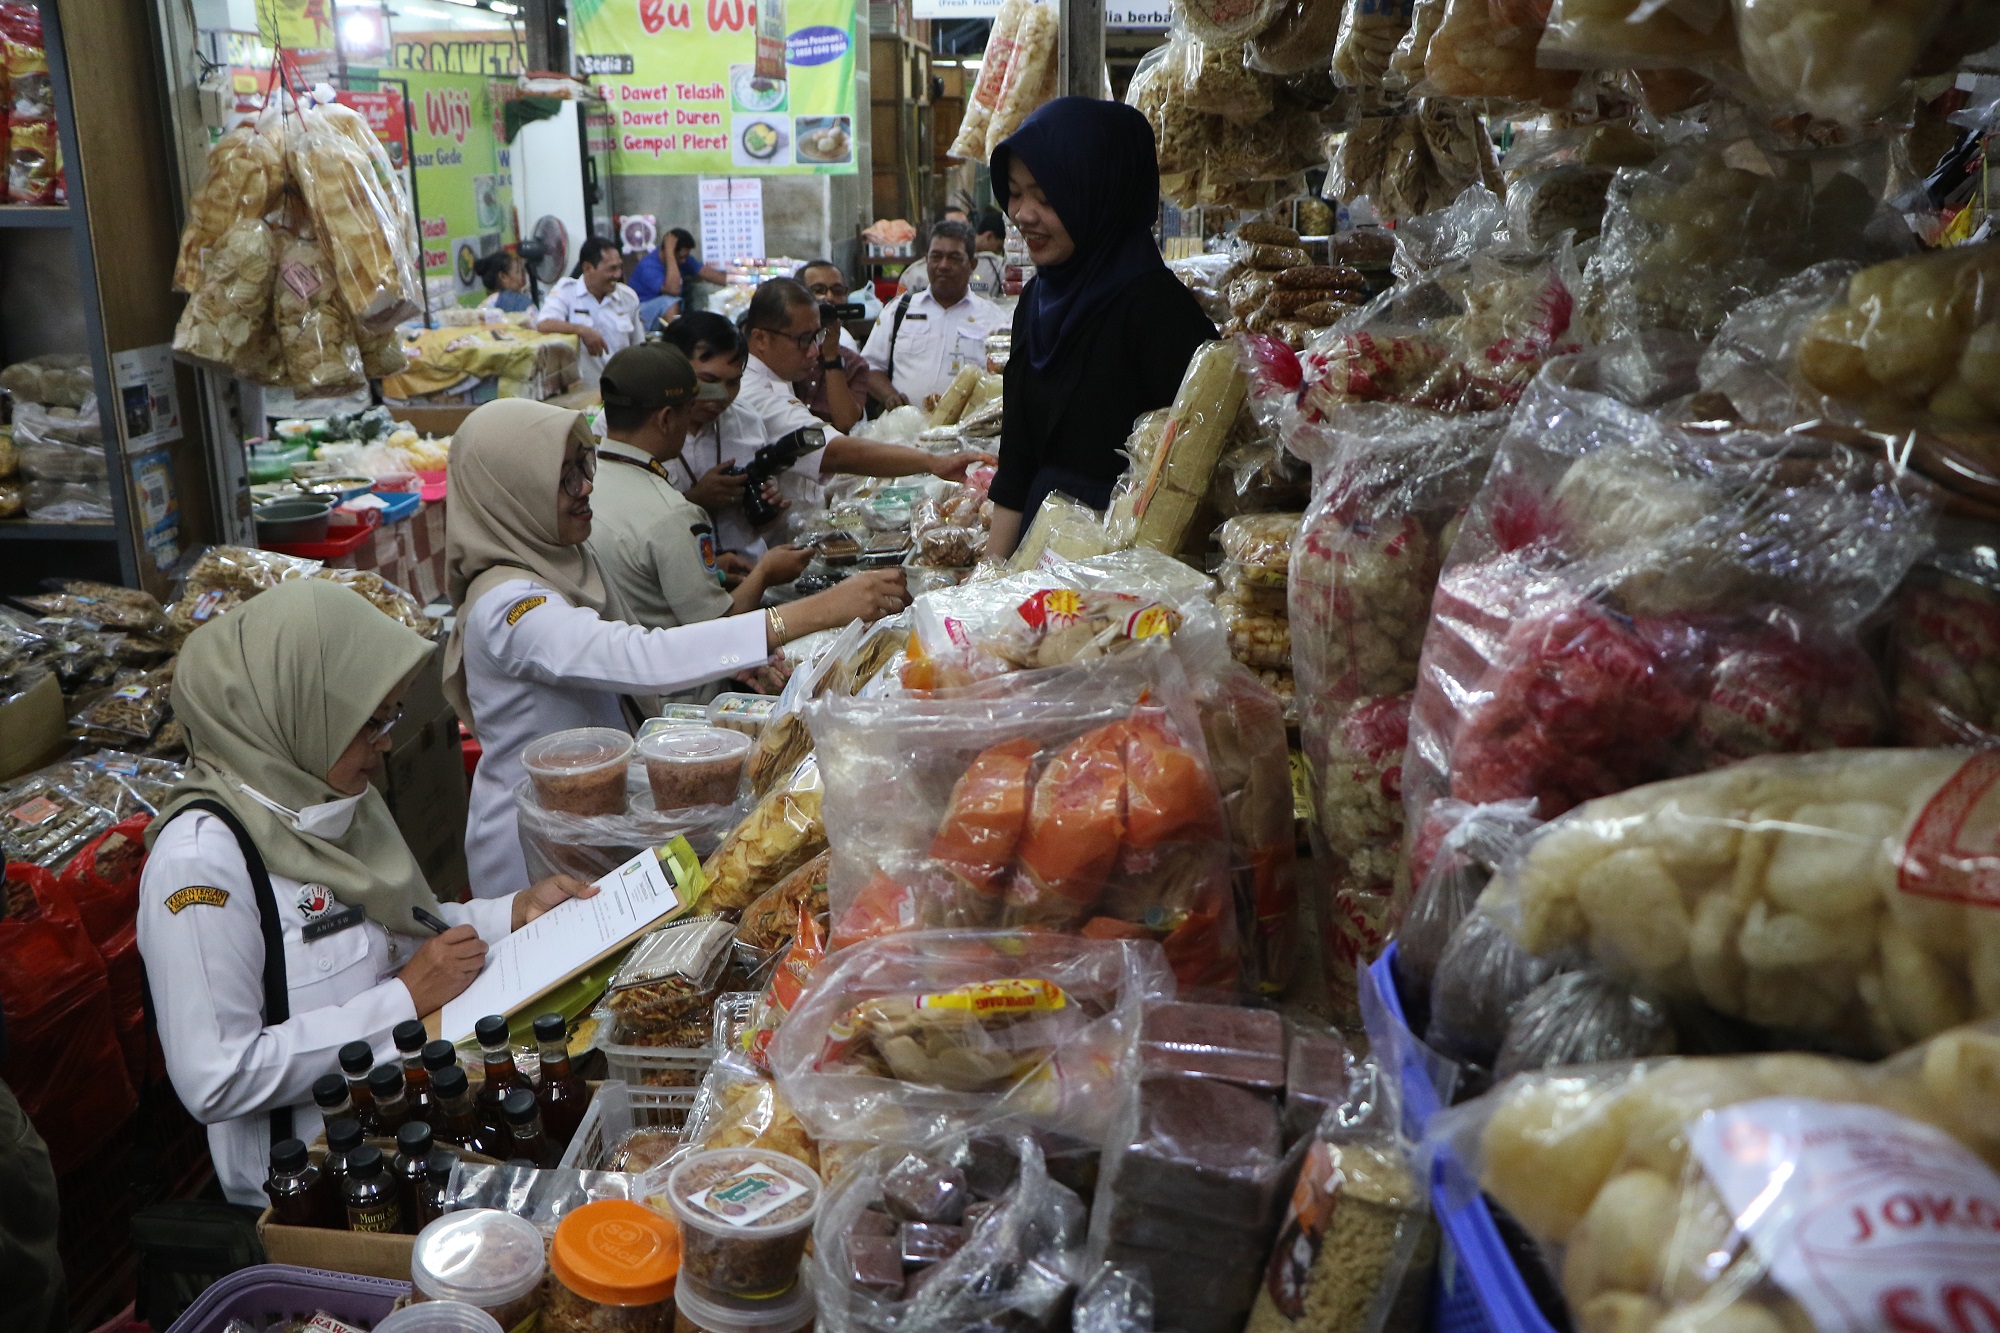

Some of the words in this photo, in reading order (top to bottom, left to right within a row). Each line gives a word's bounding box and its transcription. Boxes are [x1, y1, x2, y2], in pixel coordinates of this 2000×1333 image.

[639, 0, 690, 34] Bu
[430, 42, 512, 75] DAWET
[584, 56, 622, 74] Sedia
[622, 84, 668, 100] Dawet
[676, 83, 725, 99] Telasih
[425, 91, 471, 143] Wiji
[623, 109, 669, 125] Dawet
[676, 109, 720, 125] Duren
[624, 134, 676, 158] Gempol
[683, 134, 728, 150] Pleret
[436, 147, 462, 165] Gede
[169, 887, 225, 906] KEMENTERIAN
[316, 922, 335, 933] ANIK
[359, 1212, 386, 1224] Murni
